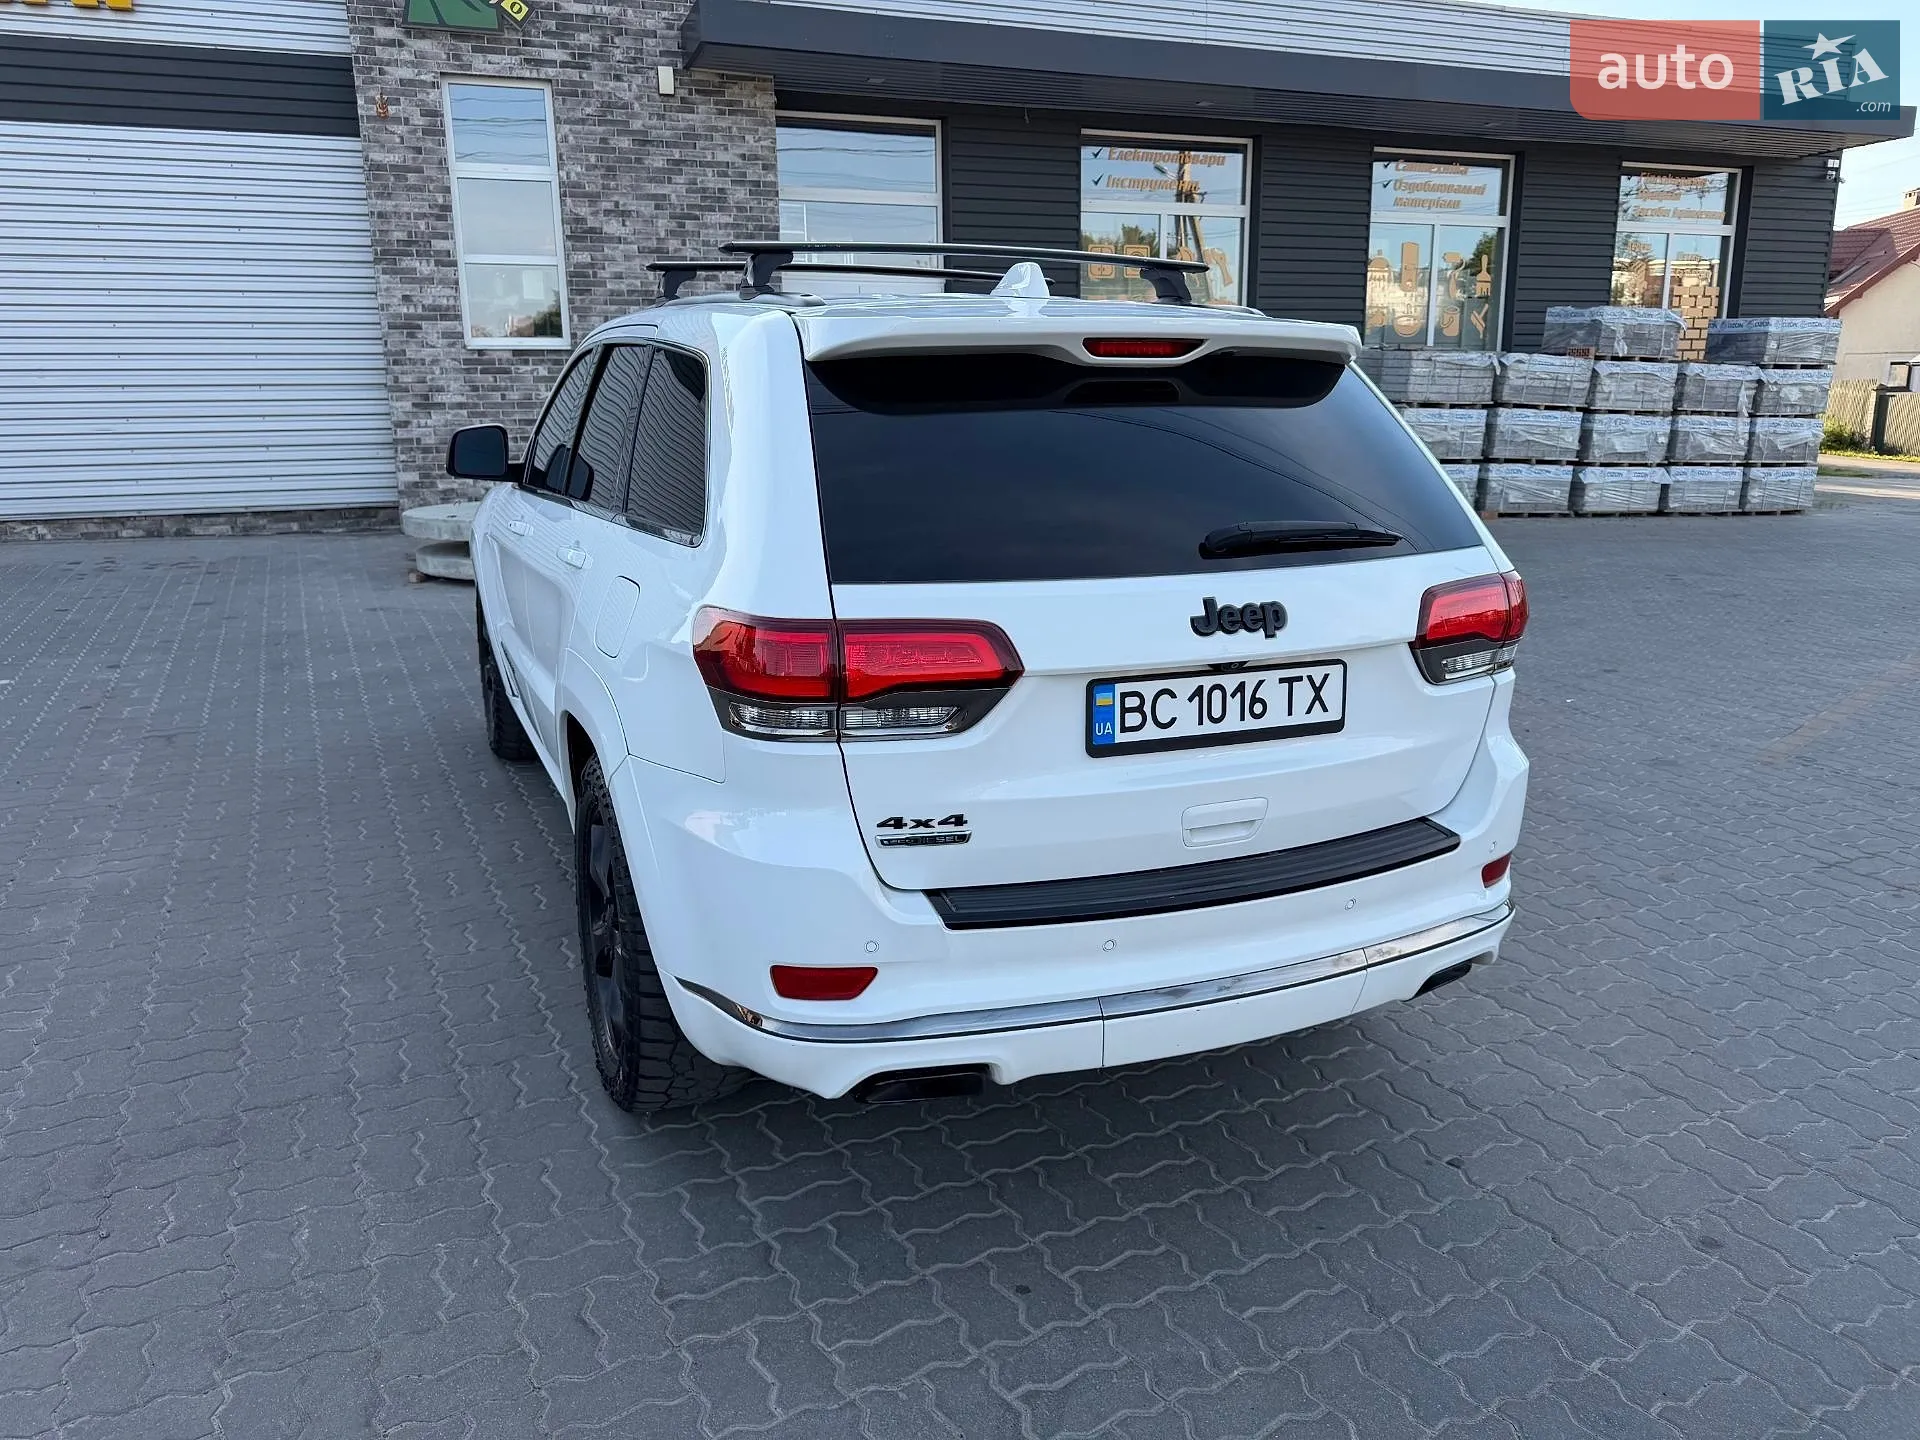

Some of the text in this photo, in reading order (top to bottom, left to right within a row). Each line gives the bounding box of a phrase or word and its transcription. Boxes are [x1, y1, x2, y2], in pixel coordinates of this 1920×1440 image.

[1189, 596, 1288, 639] Jeep
[1119, 673, 1330, 734] BC 1016 TX
[1095, 722, 1113, 736] UA
[876, 813, 968, 829] 4x4
